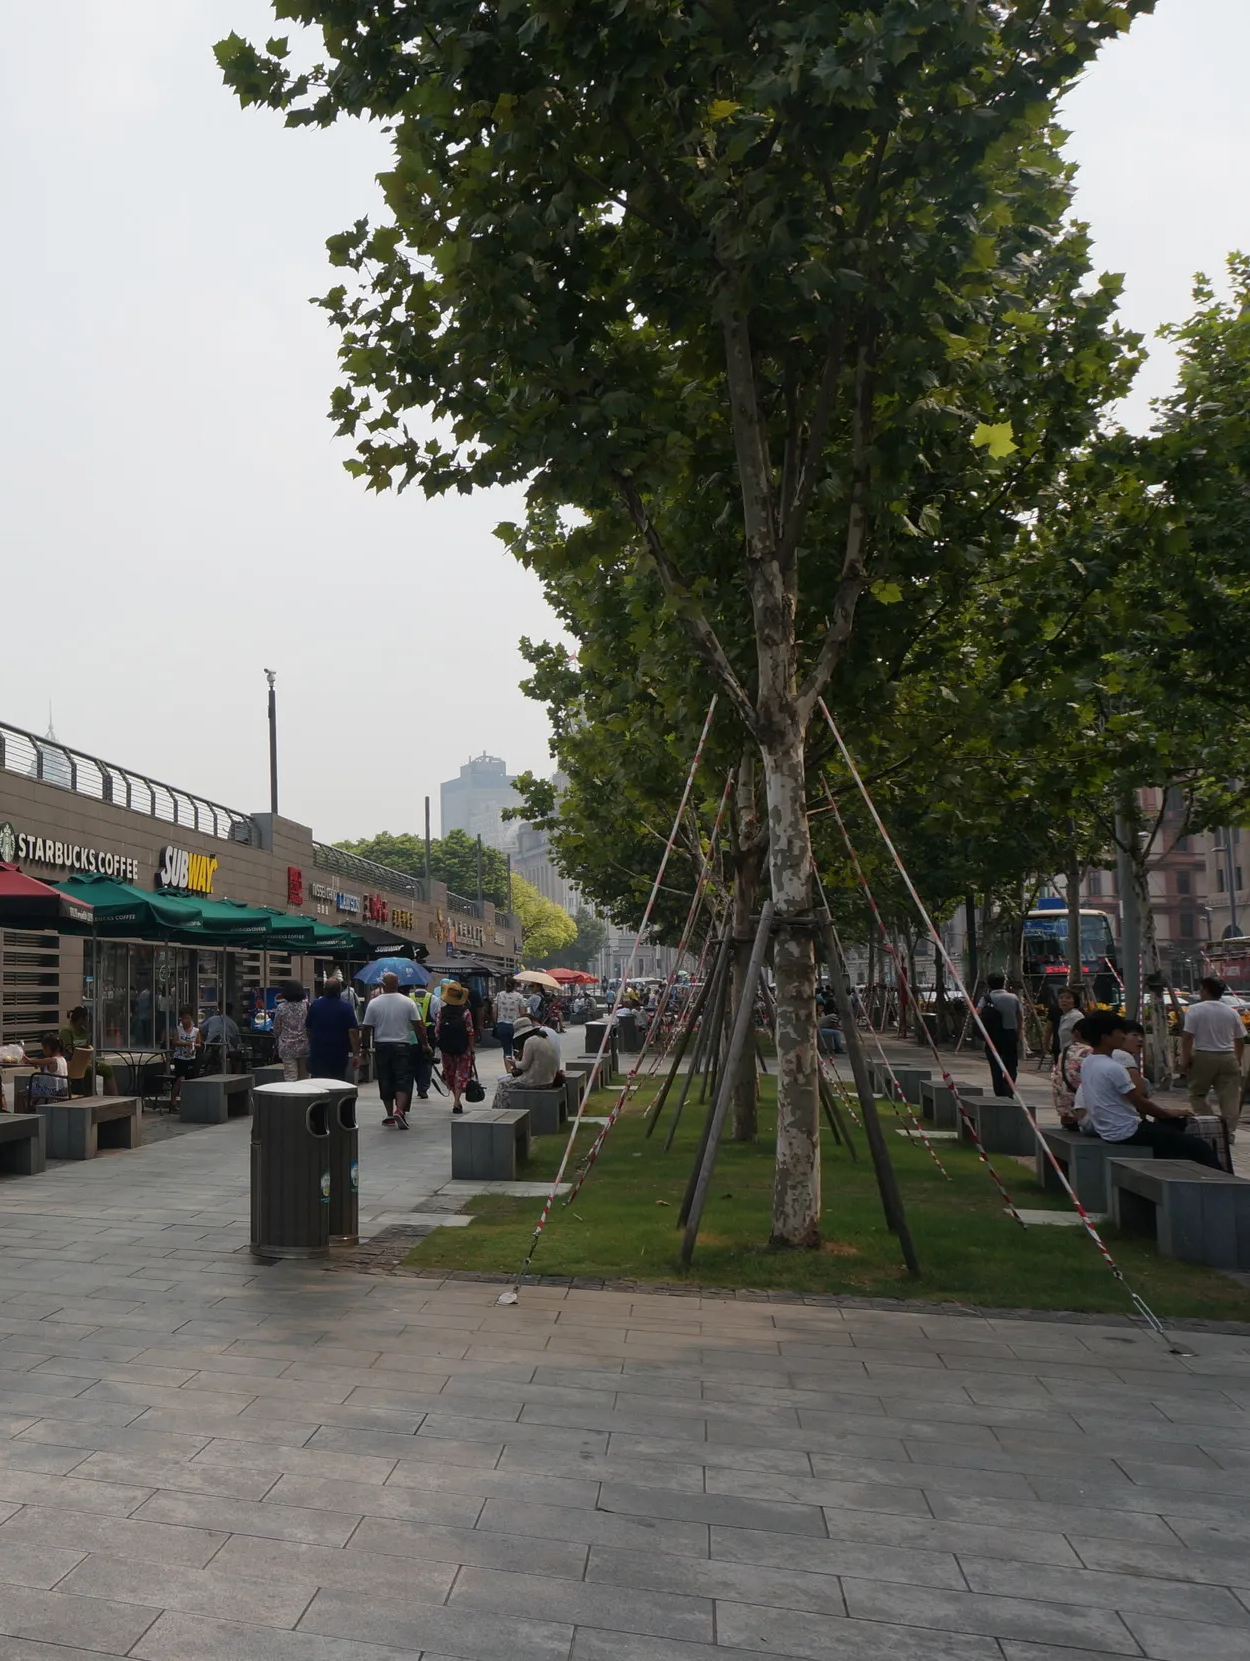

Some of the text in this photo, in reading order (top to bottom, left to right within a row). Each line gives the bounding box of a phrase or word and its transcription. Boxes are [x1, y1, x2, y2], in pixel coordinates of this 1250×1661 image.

[18, 833, 139, 880] STARBUCKS COFFEE
[160, 845, 219, 894] SUBWAY
